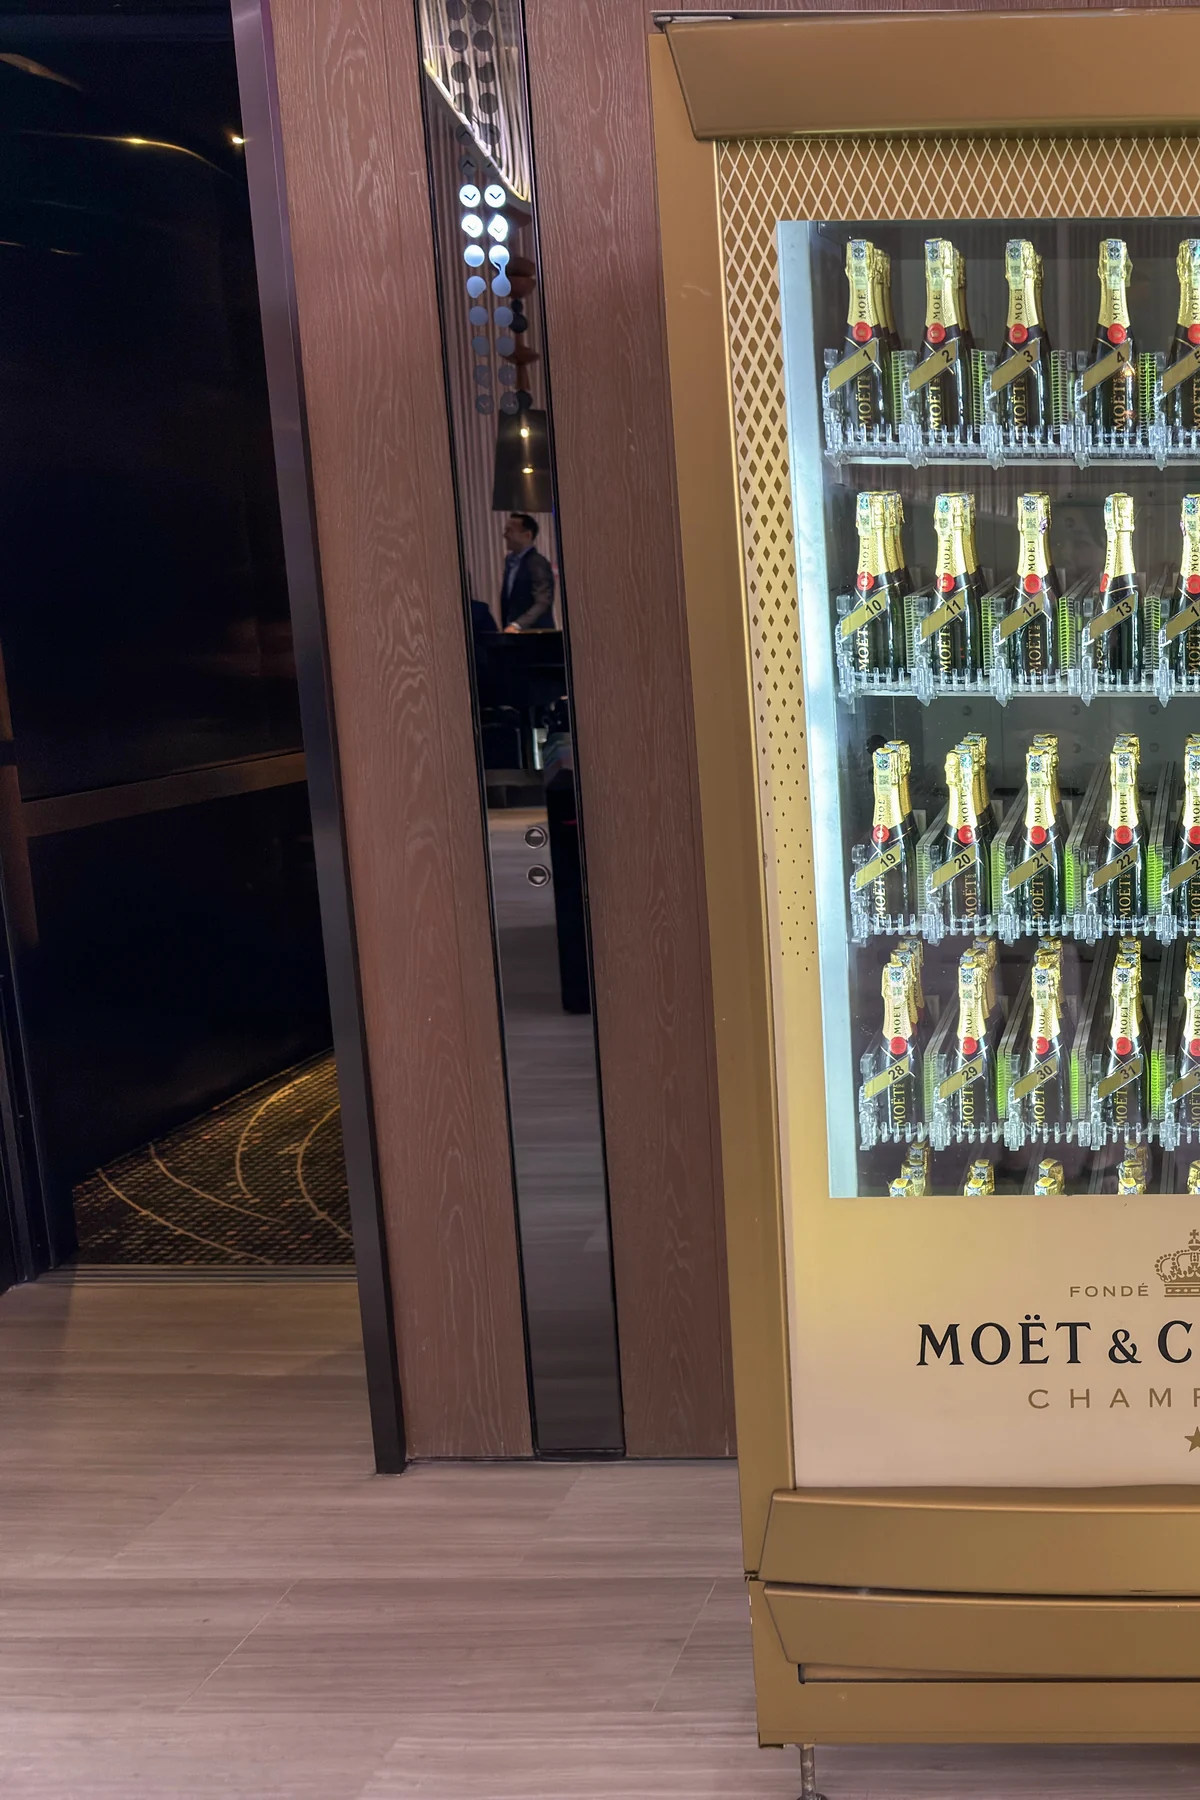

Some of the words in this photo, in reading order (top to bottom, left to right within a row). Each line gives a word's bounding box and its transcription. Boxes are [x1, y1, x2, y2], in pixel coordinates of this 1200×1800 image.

[862, 350, 872, 362] 1
[942, 350, 953, 363] 2
[1023, 350, 1034, 363] 3
[1116, 351, 1125, 363] 4
[865, 599, 882, 616] 10
[946, 599, 962, 615] 11
[1022, 601, 1040, 618] 12
[1116, 601, 1132, 617] 13
[880, 852, 896, 868] 19
[954, 853, 971, 870] 20
[1032, 852, 1050, 869] 21
[1116, 853, 1134, 871] 22
[887, 1064, 906, 1081] 28
[961, 1065, 978, 1081] 29
[1036, 1064, 1053, 1081] 30
[1120, 1064, 1137, 1080] 31
[1069, 1283, 1149, 1298] FONDÉ
[915, 1313, 1092, 1366] MOËT
[1107, 1328, 1143, 1364] &
